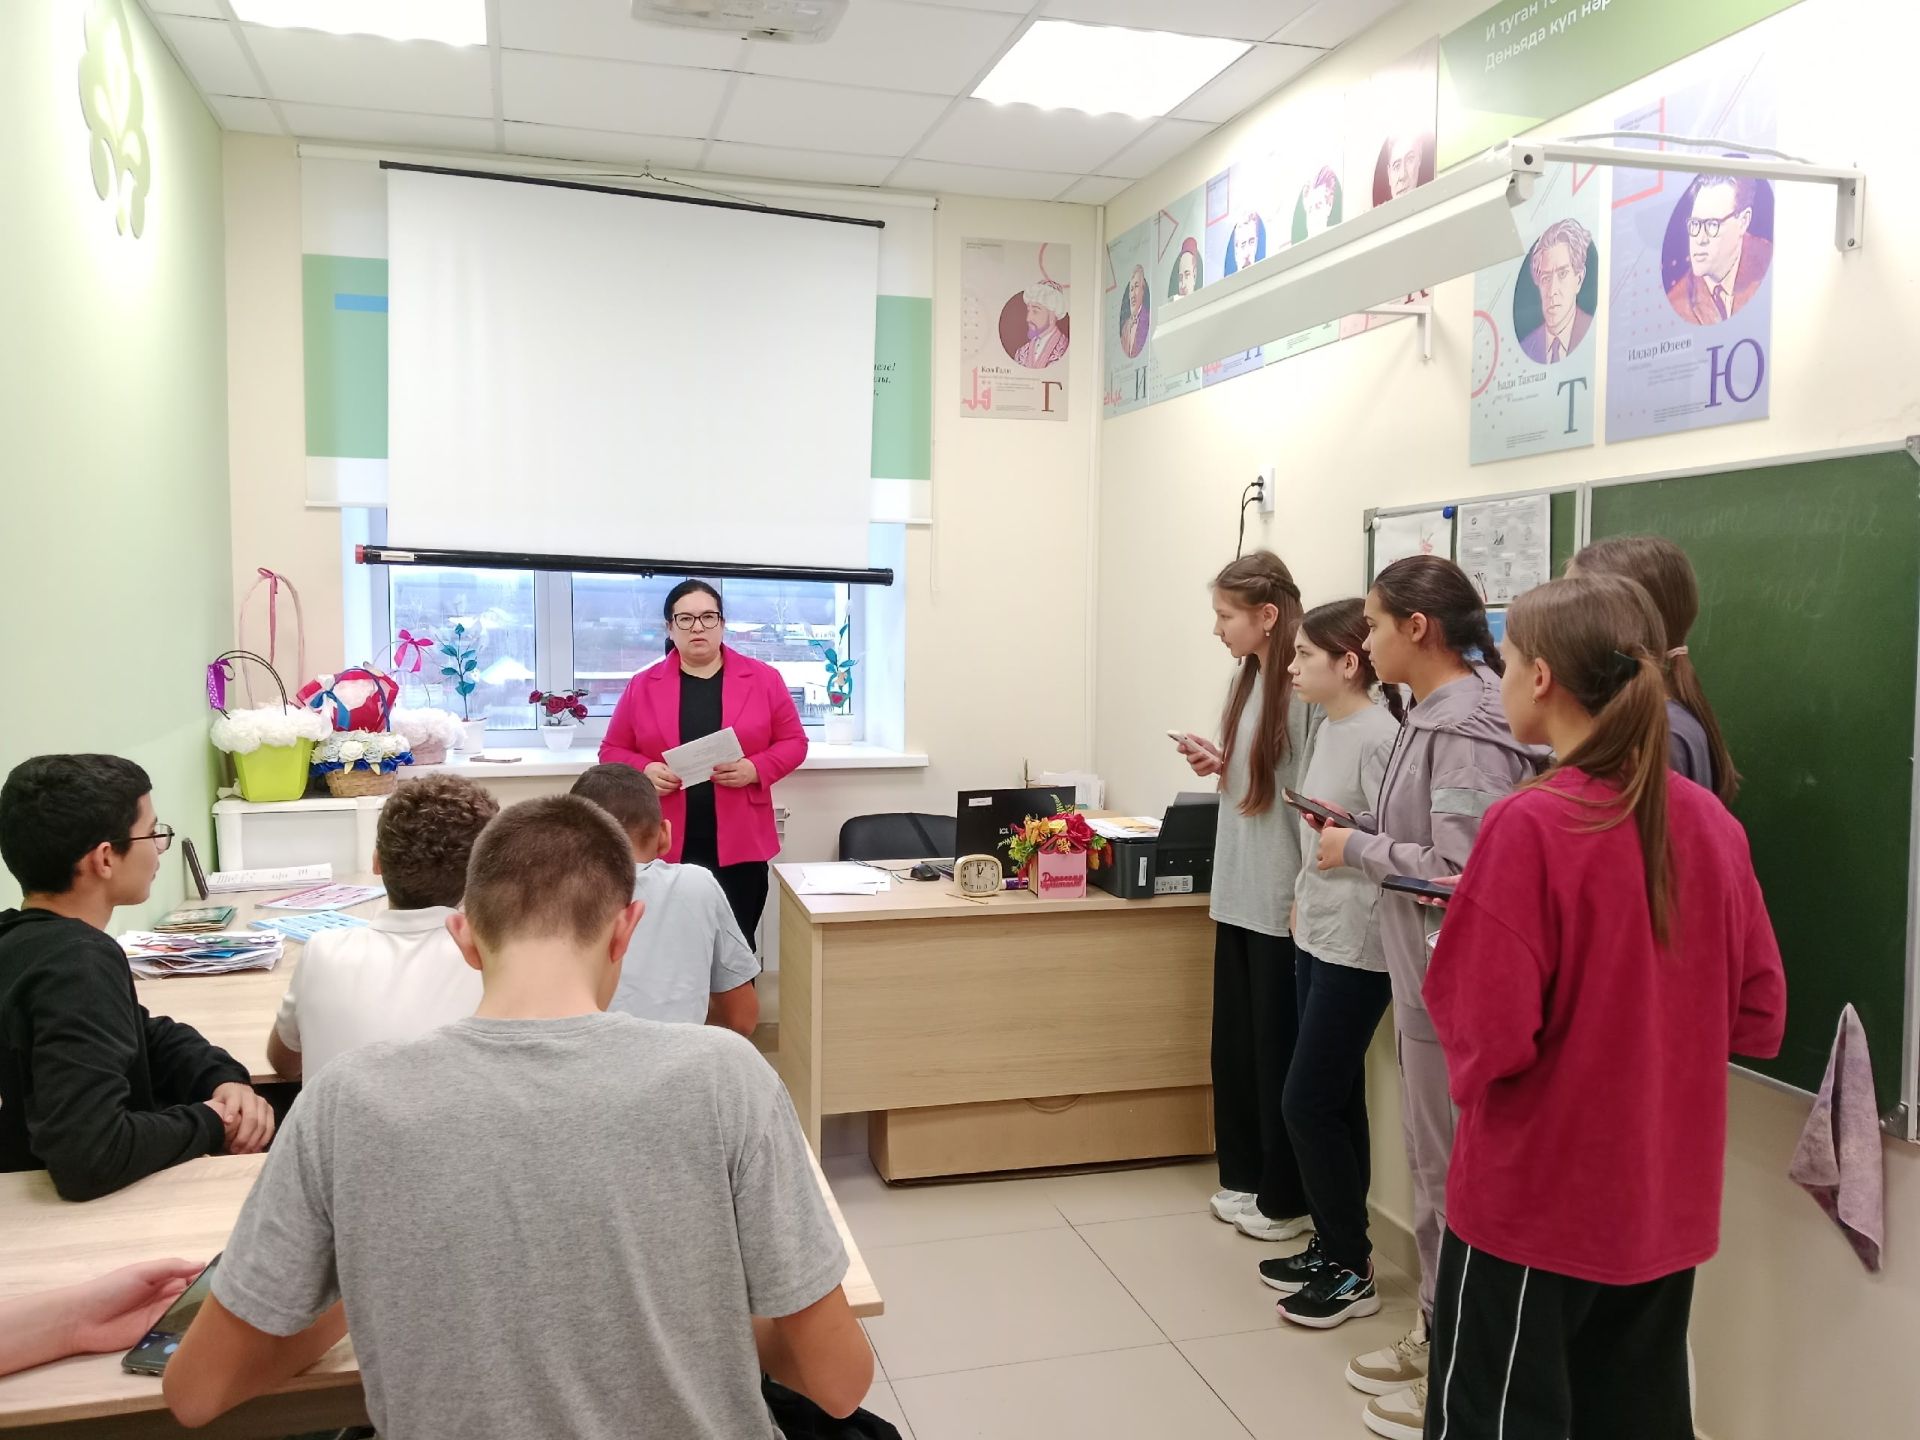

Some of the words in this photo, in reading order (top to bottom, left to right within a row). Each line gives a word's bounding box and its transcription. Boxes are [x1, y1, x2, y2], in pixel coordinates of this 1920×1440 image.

[1485, 23, 1496, 41] И
[1500, 2, 1538, 34] туган
[1485, 27, 1546, 72] Дөньяда
[1550, 9, 1577, 34] күп
[1628, 346, 1657, 361] Илдар
[1660, 339, 1692, 354] Юзеев
[1134, 366, 1147, 402] И
[1705, 338, 1765, 408] Ю
[1041, 381, 1063, 412] Г
[1557, 376, 1588, 434] Т
